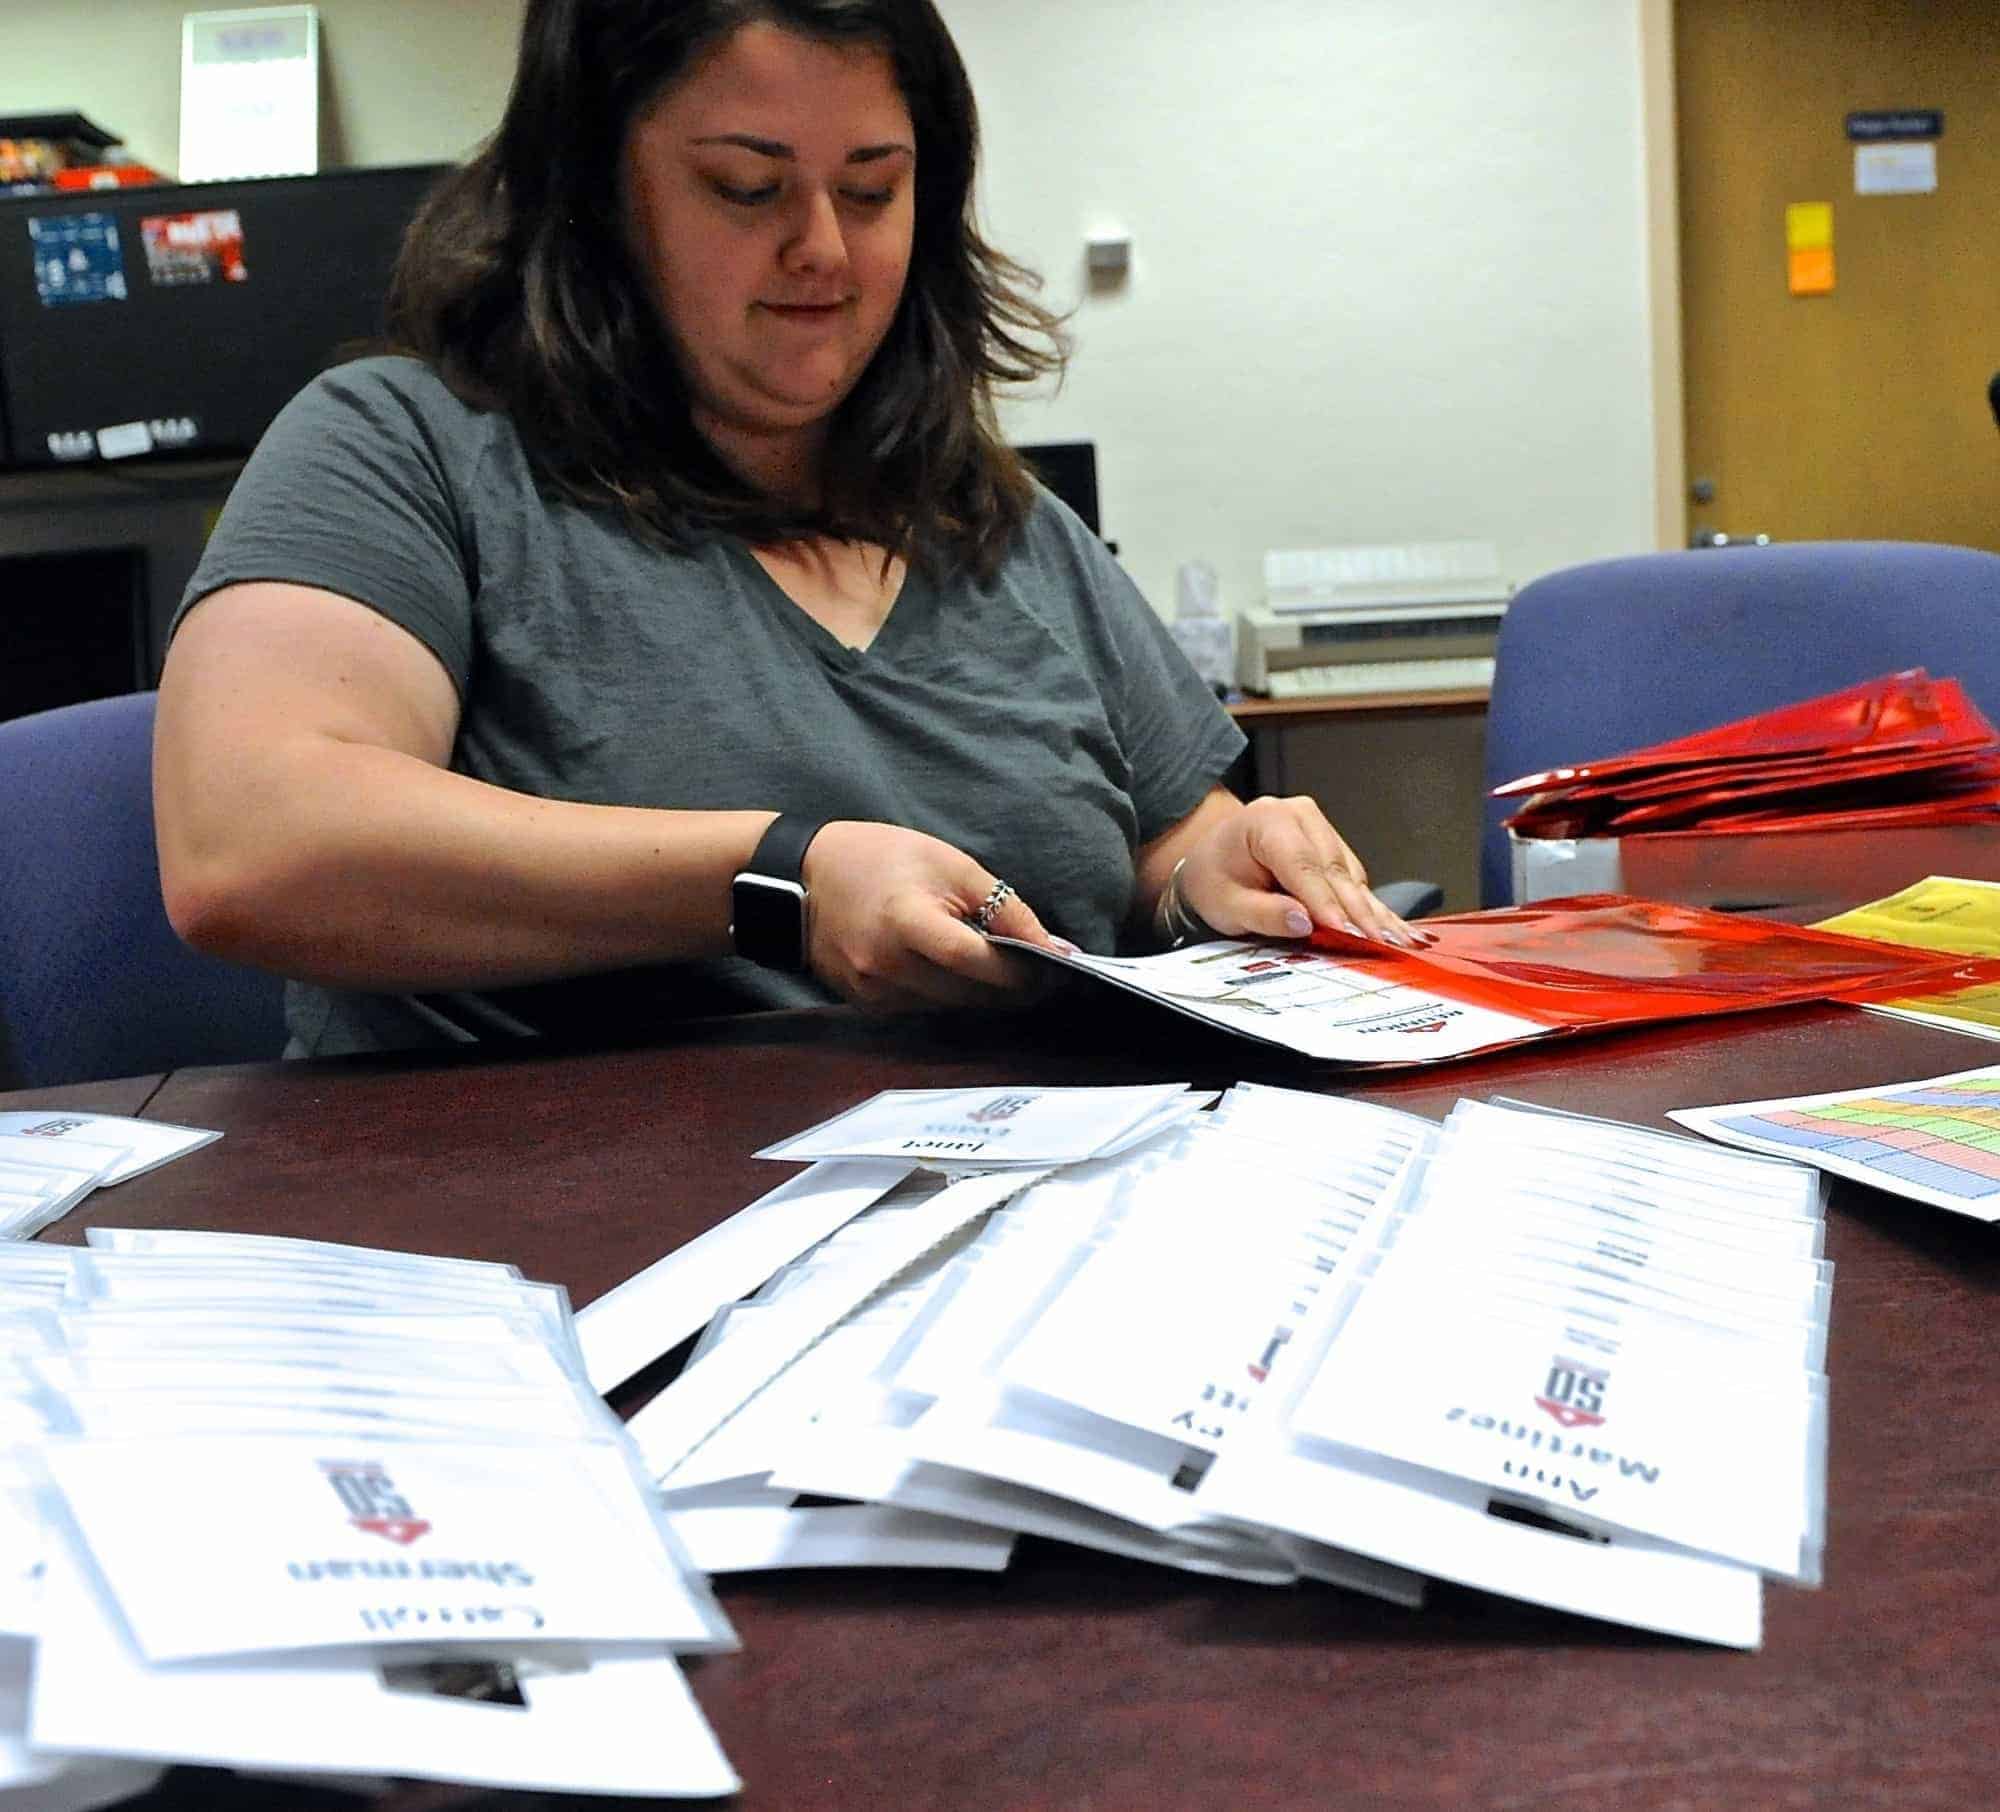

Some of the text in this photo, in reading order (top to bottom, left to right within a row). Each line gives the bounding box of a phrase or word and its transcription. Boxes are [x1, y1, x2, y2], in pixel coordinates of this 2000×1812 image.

[1356, 1009, 1464, 1034] REUNION
[1445, 1407, 1660, 1484] Martinez
[1502, 1460, 1598, 1502] Ann
[286, 1559, 536, 1588] Sherman
[360, 1606, 545, 1631] Carroll
